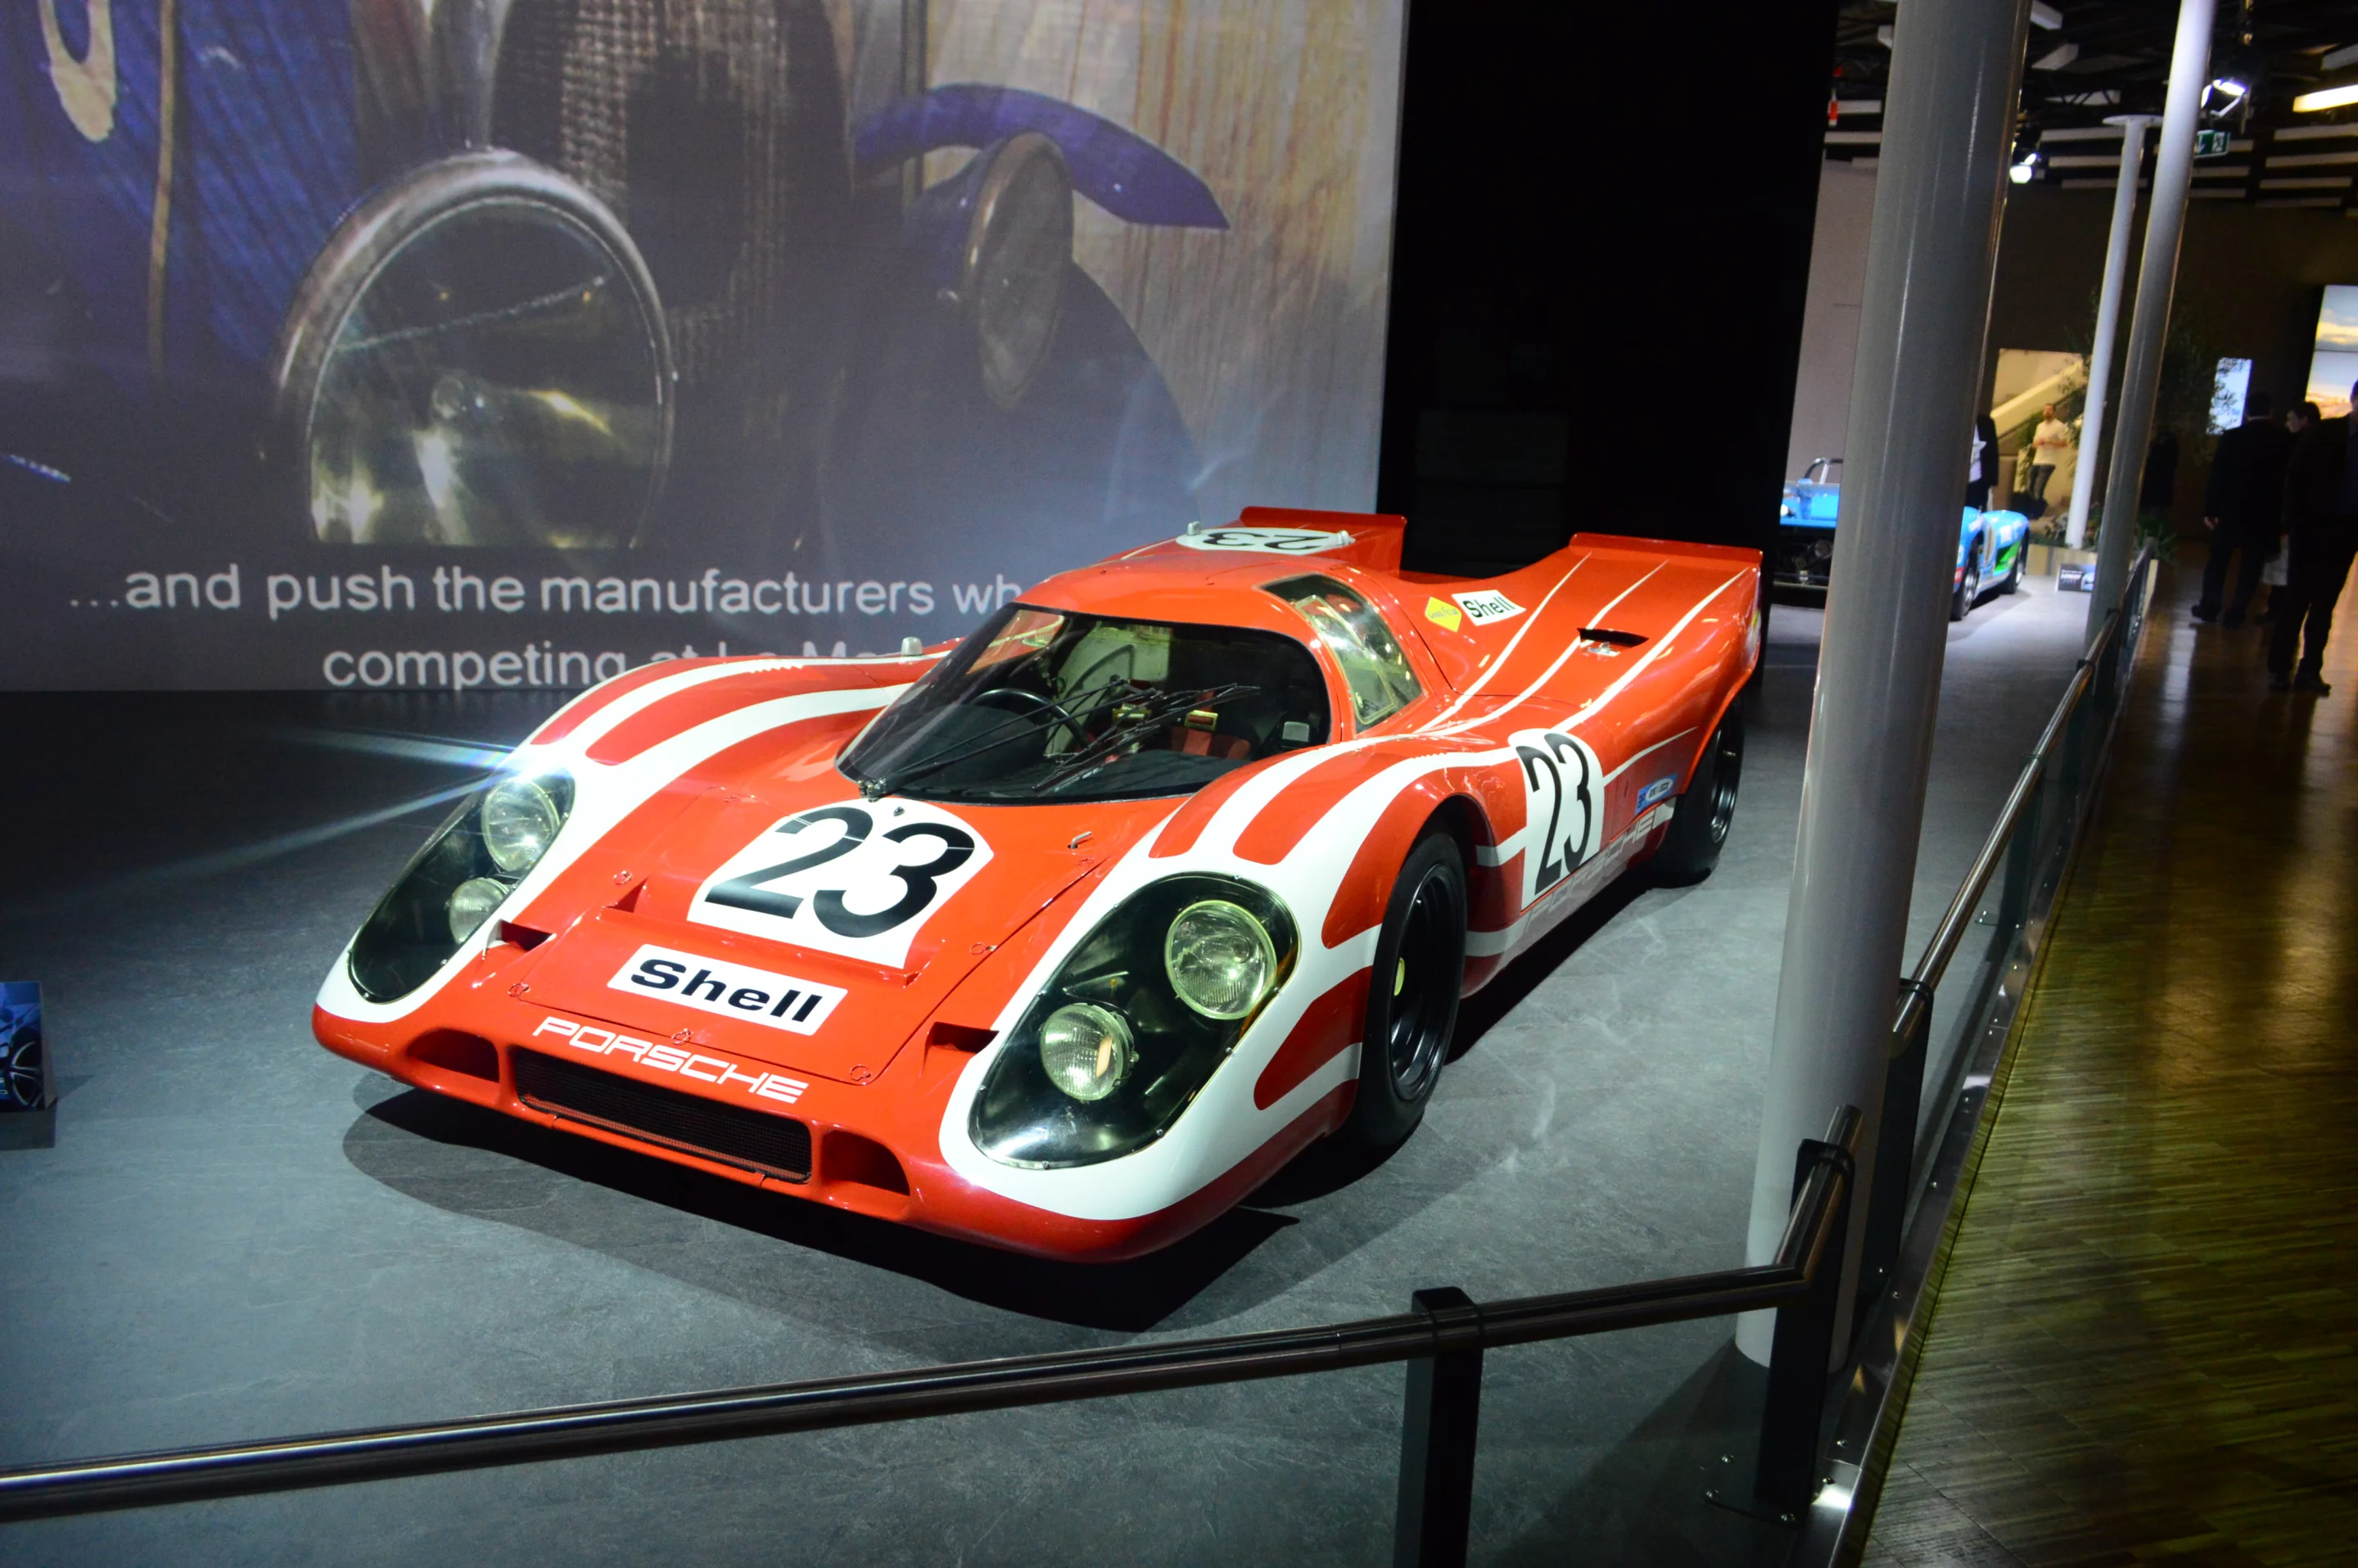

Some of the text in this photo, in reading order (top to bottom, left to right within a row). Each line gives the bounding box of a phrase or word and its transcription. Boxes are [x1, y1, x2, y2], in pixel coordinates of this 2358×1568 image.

[1202, 531, 1330, 551] 23
[268, 565, 414, 619] push
[432, 566, 525, 612] the
[540, 567, 935, 617] manufacturers
[1462, 596, 1516, 618] Shell
[323, 642, 627, 690] competing
[1515, 732, 1592, 896] 23
[705, 806, 975, 938] 23
[630, 958, 823, 1023] Shell
[532, 1016, 809, 1105] PORSCHE
